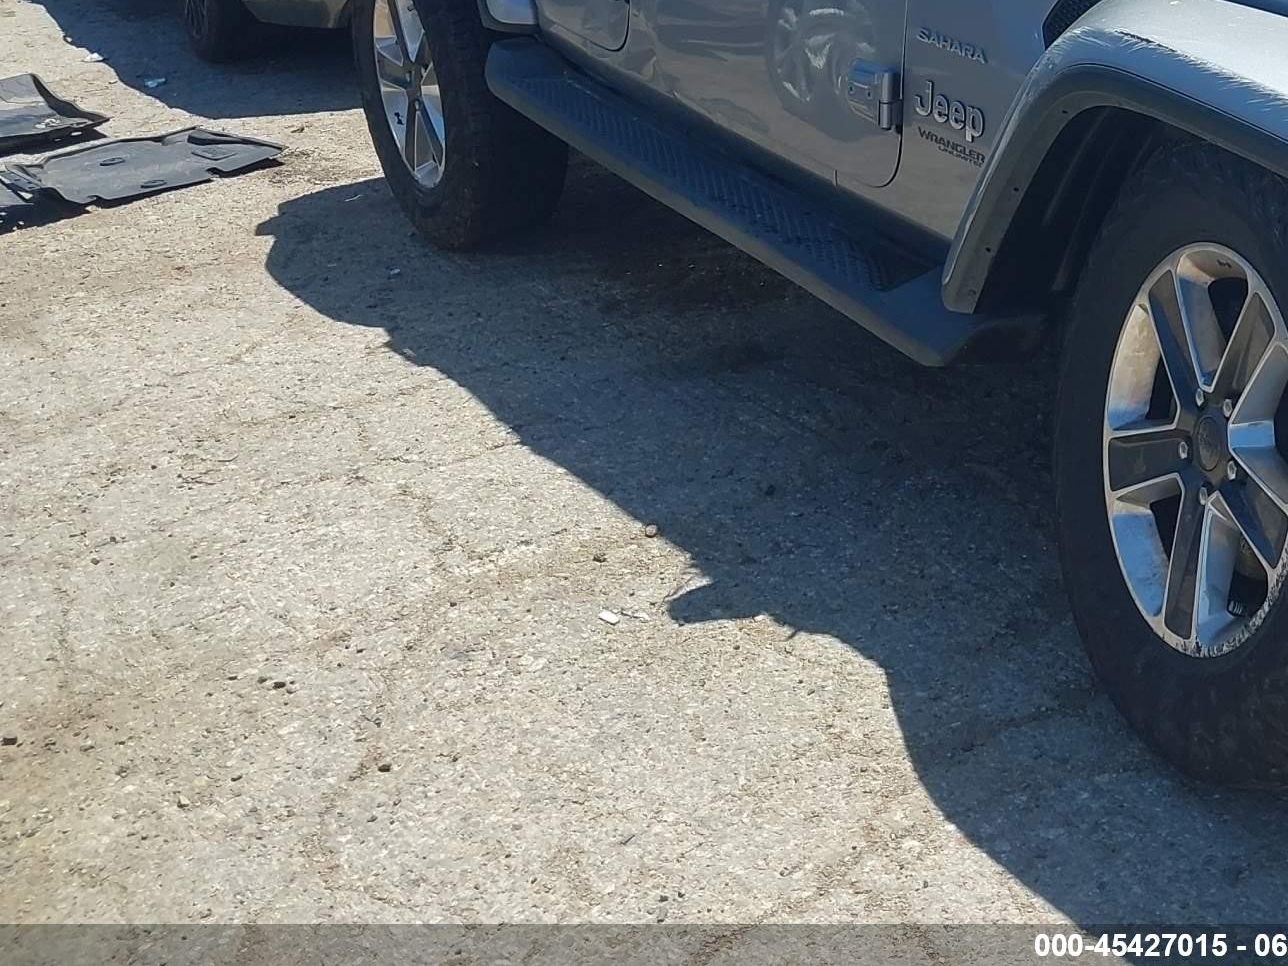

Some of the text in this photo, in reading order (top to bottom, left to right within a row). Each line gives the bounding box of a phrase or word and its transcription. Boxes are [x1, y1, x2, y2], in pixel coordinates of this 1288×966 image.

[916, 27, 986, 64] SAHARA
[914, 80, 986, 143] Jeep
[918, 125, 985, 164] WRANGLER
